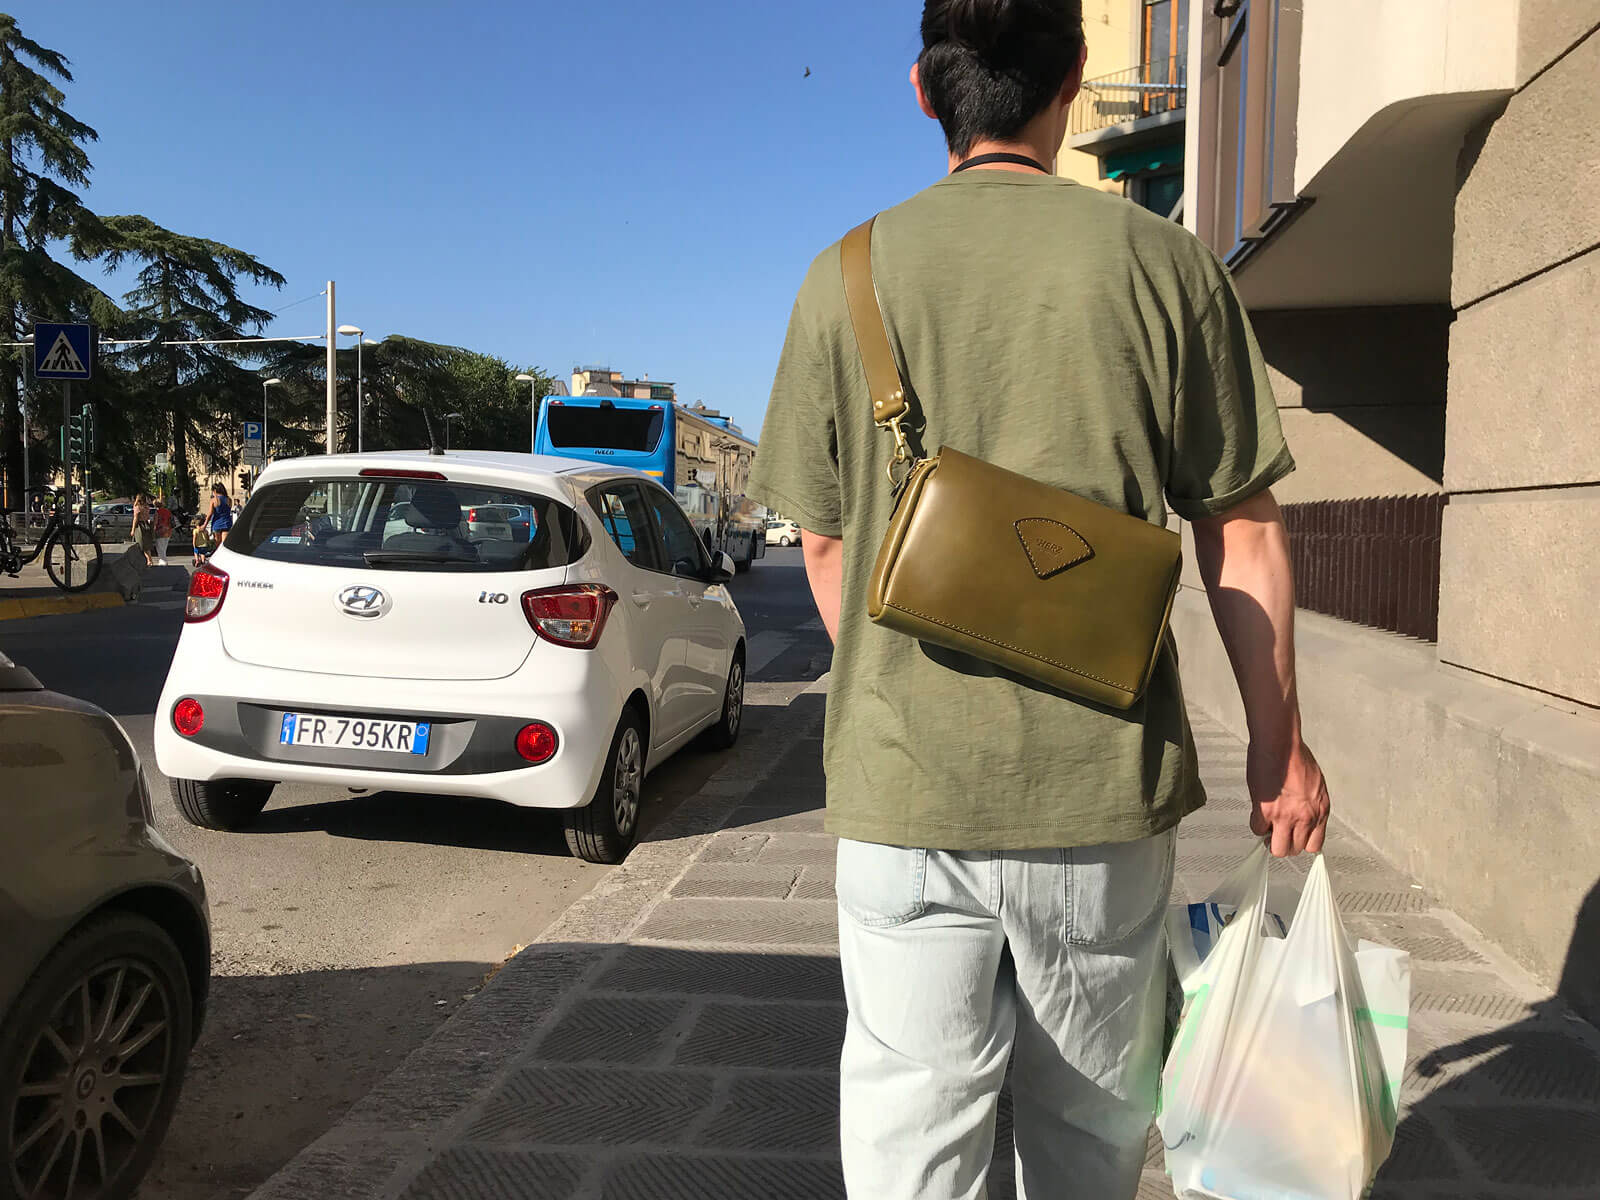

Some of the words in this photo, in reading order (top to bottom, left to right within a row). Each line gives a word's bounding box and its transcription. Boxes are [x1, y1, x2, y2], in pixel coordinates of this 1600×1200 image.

[247, 423, 259, 438] P
[297, 717, 327, 744] FR
[335, 719, 412, 750] 795KR
